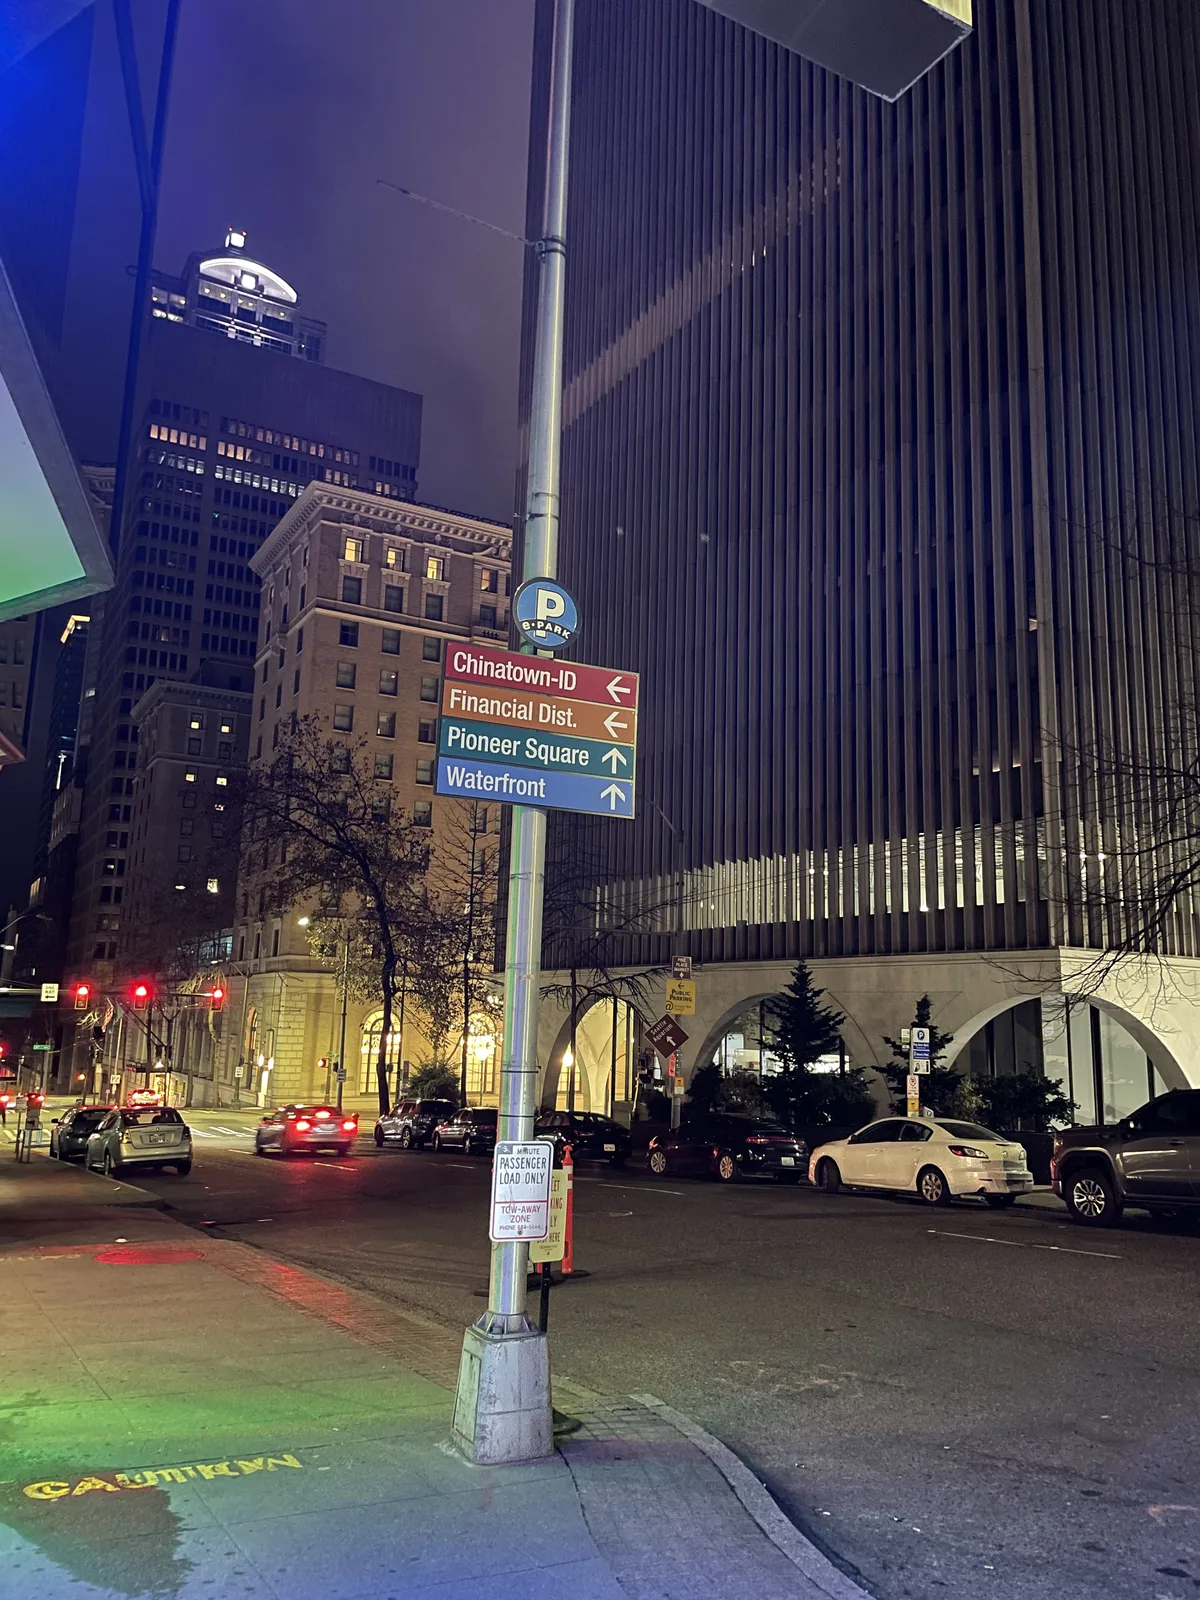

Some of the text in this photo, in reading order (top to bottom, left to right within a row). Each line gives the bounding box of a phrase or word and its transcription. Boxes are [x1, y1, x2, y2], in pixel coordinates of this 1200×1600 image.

[453, 651, 577, 692] Chinatown-ID
[450, 688, 577, 728] Financial Dist.
[447, 726, 590, 766] Pioneer Square
[446, 765, 546, 798] Waterfront
[669, 994, 692, 1002] PARKING
[671, 988, 691, 996] PUBLIC
[650, 1019, 667, 1036] Seattle
[652, 1023, 674, 1043] Aquarium
[499, 1157, 547, 1170] PASSENGER
[499, 1172, 546, 1185] LOAD ONLY
[501, 1205, 541, 1214] TOW-AWAY
[510, 1214, 531, 1223] ZONE
[548, 1231, 561, 1243] HERE
